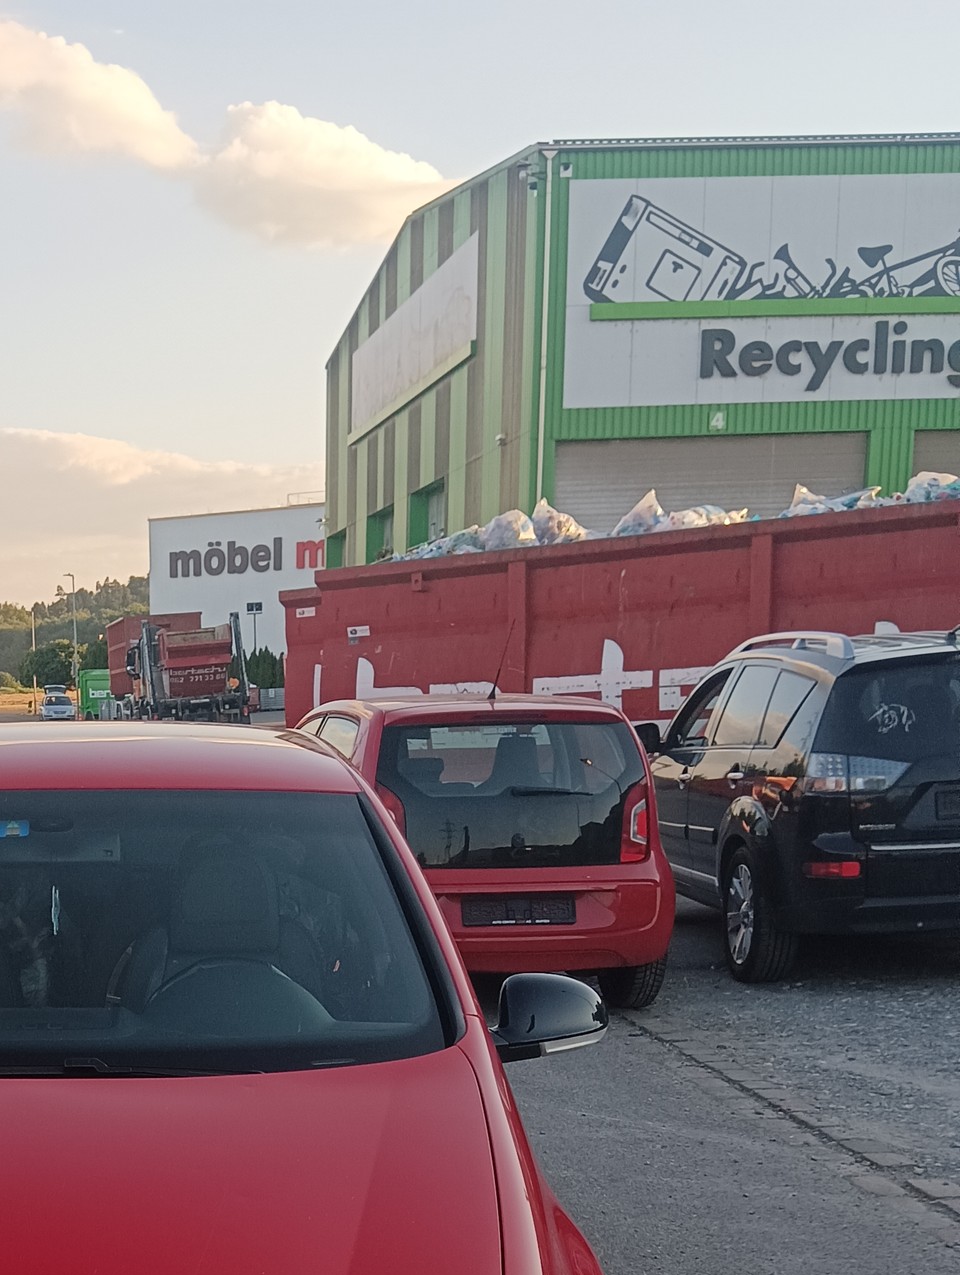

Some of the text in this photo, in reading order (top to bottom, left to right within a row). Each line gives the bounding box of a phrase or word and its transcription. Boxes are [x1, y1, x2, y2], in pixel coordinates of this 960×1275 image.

[709, 411, 726, 430] 4
[169, 537, 325, 579] möbel m
